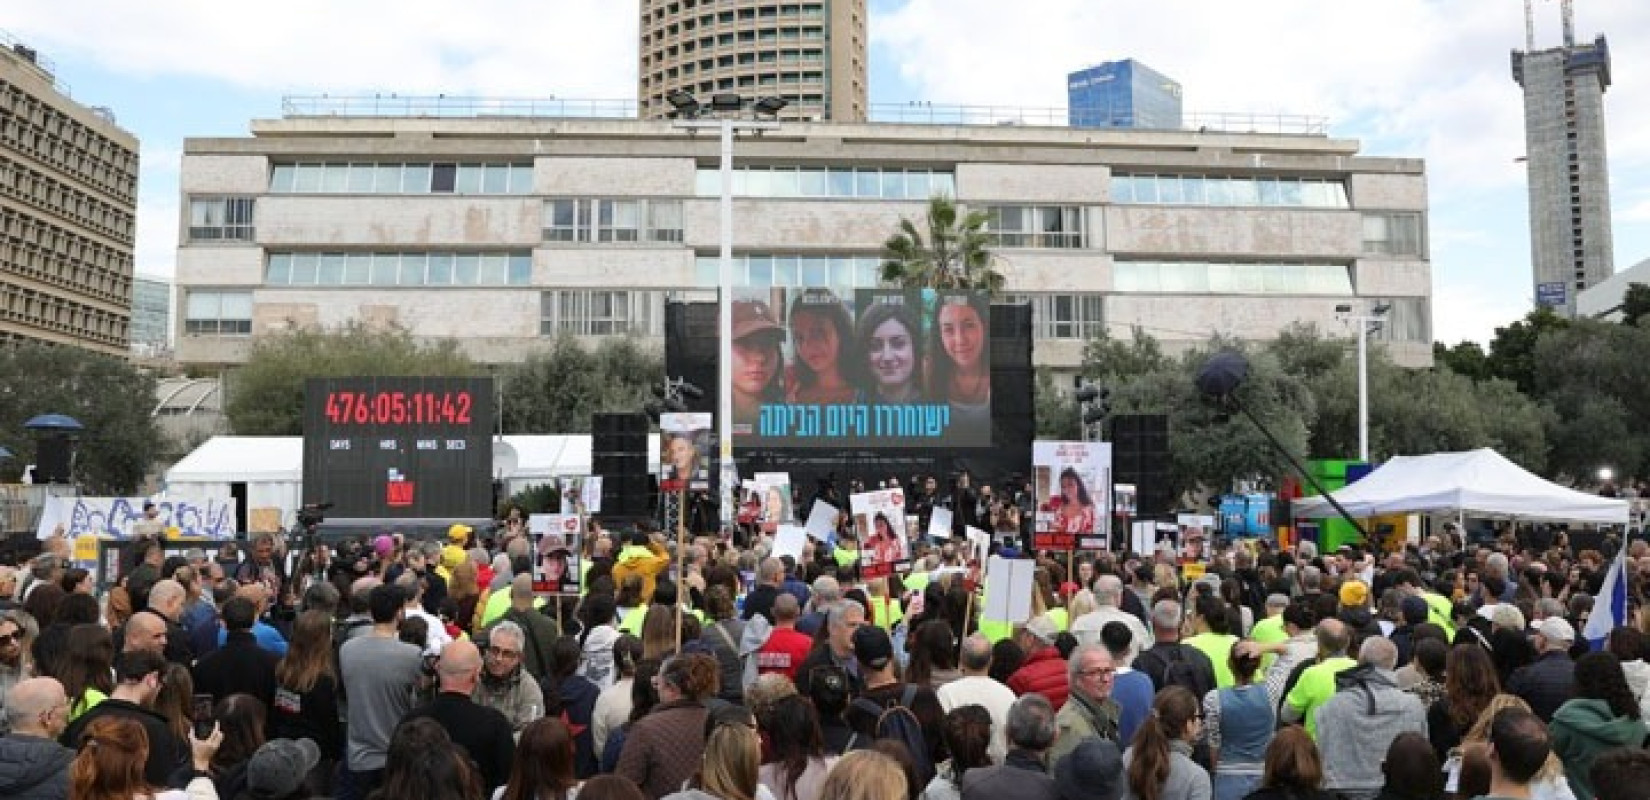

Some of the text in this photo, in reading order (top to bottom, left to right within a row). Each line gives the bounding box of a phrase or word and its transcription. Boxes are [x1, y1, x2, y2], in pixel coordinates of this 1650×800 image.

[326, 393, 471, 423] 476:05:11:42
[759, 403, 950, 437] ישוחררו היום הביתה
[330, 440, 351, 450] DAYS
